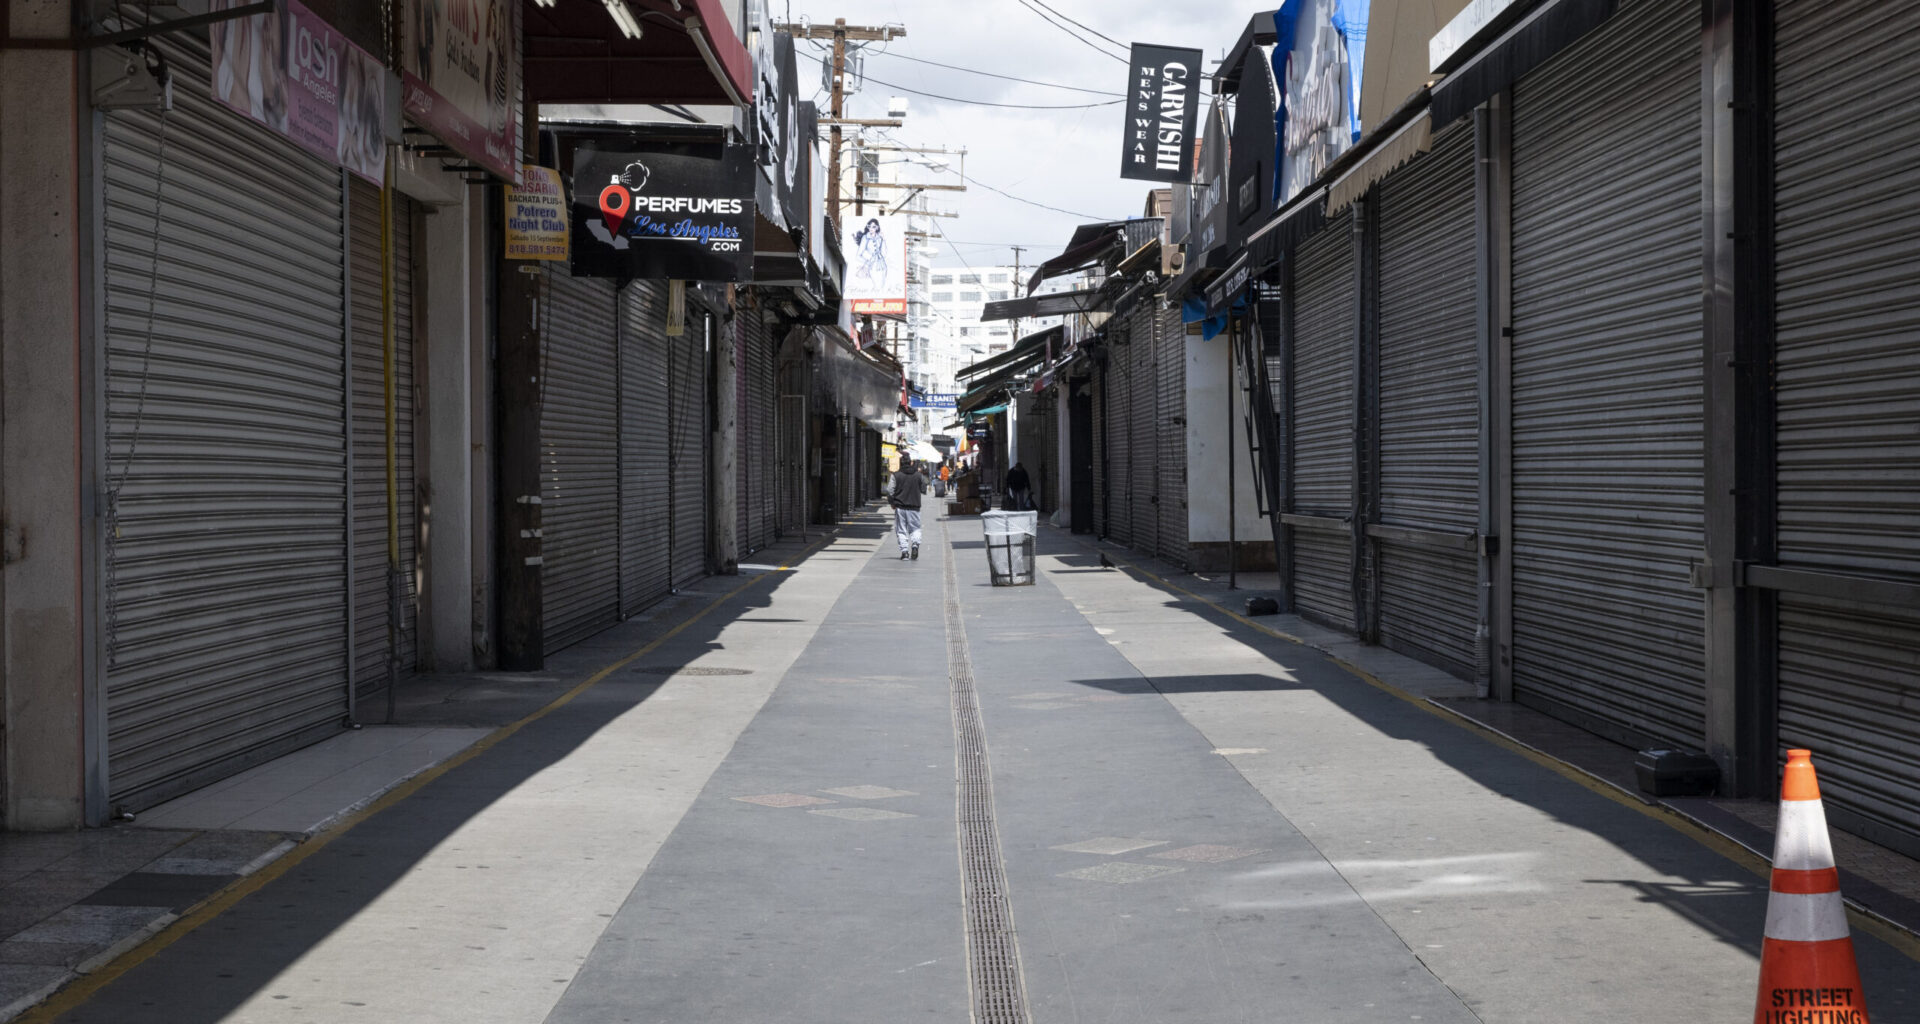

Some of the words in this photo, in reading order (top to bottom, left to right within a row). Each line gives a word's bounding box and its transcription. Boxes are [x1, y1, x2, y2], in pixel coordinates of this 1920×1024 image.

[289, 12, 338, 86] Lash
[303, 72, 336, 105] Angeles
[1138, 66, 1156, 111] MEN'S
[1134, 118, 1153, 163] WEAR
[508, 194, 540, 204] BACHATA
[635, 196, 743, 214] PERFUMES
[517, 205, 557, 218] Potrero
[509, 217, 540, 233] Night
[542, 218, 565, 232] Club
[627, 215, 667, 236] Los
[668, 218, 740, 245] Angeles
[711, 242, 740, 252] .COM
[1771, 988, 1853, 1007] STREET
[1765, 1009, 1861, 1024] LIGHTING
